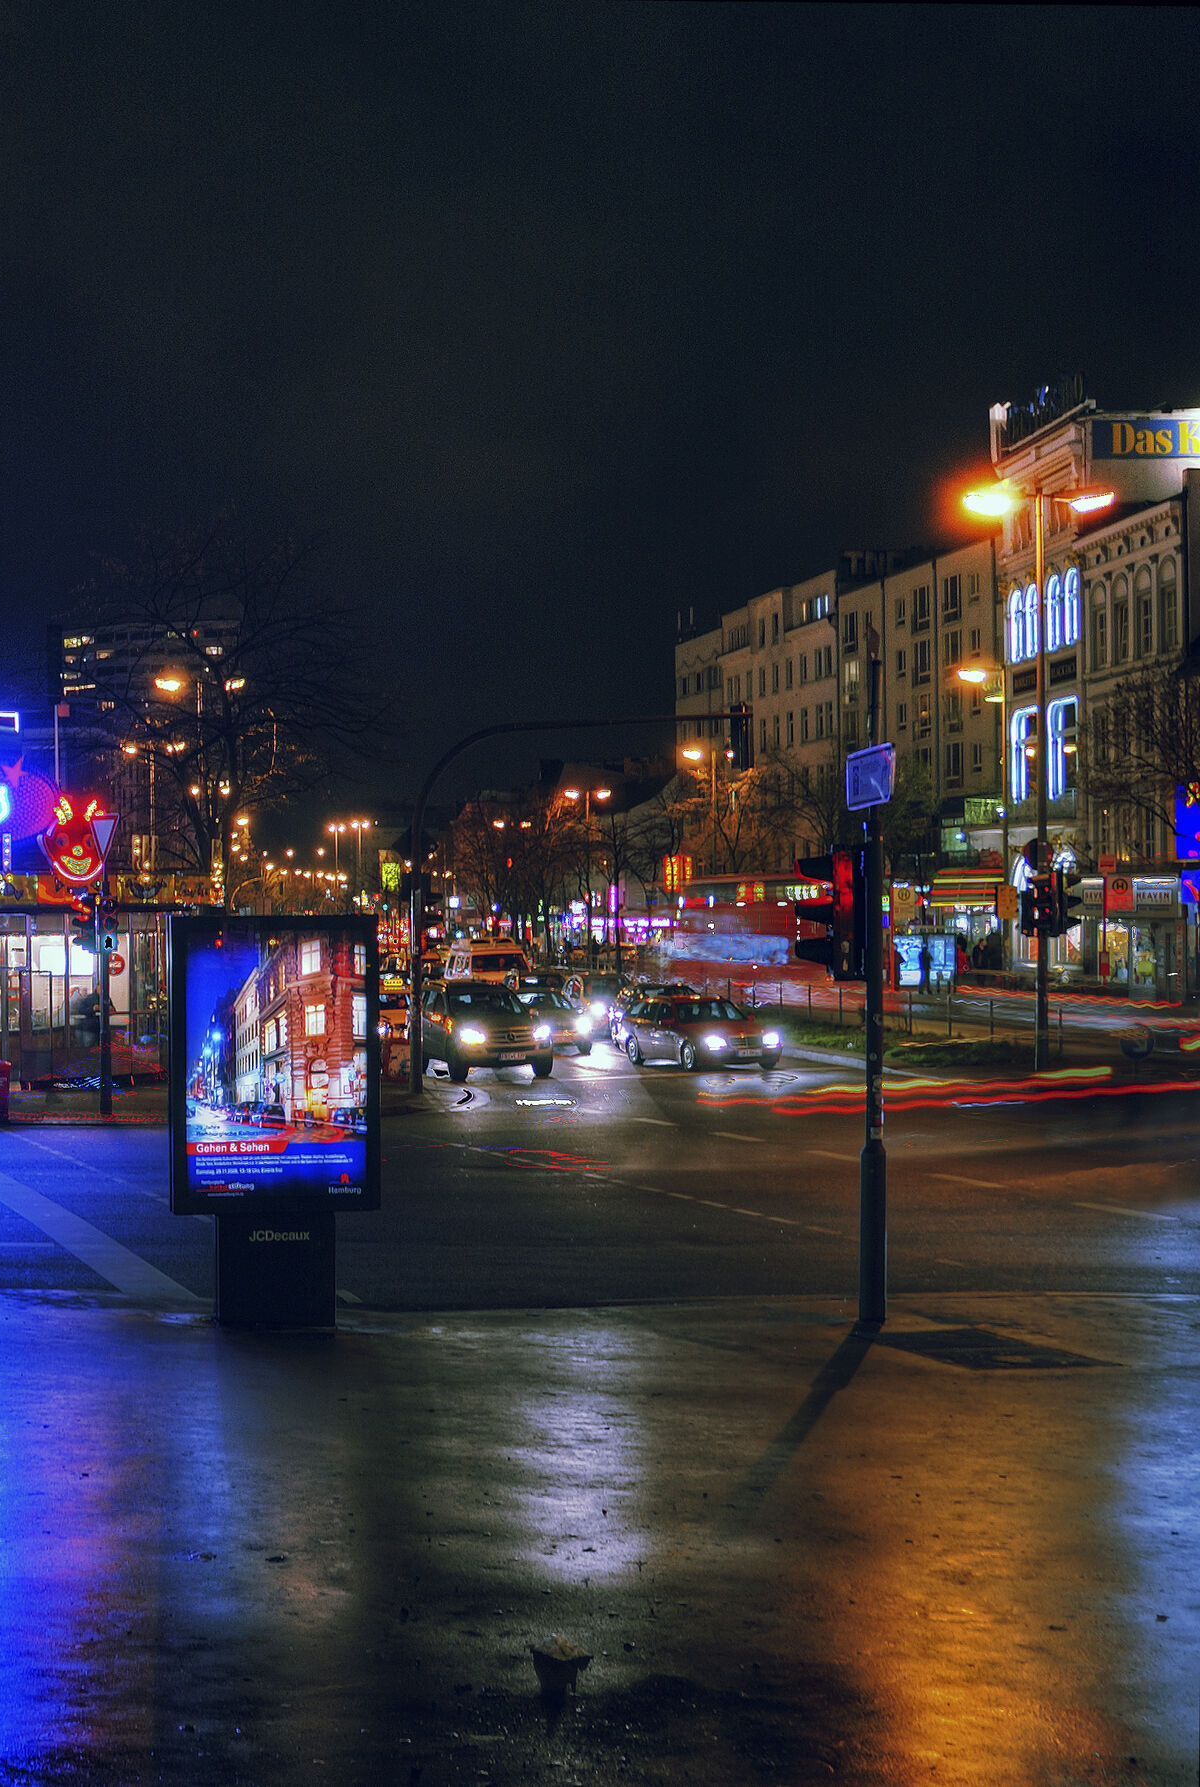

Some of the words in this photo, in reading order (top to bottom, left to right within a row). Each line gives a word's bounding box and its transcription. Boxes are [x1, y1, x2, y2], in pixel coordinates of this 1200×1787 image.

[1112, 422, 1173, 455] Das
[1084, 891, 1102, 901] SEVE
[196, 1143, 227, 1153] Gehen
[229, 1142, 238, 1152] &
[240, 1142, 270, 1152] Sehen
[328, 1186, 362, 1195] Hamburg
[249, 1230, 310, 1242] JCDecaux
